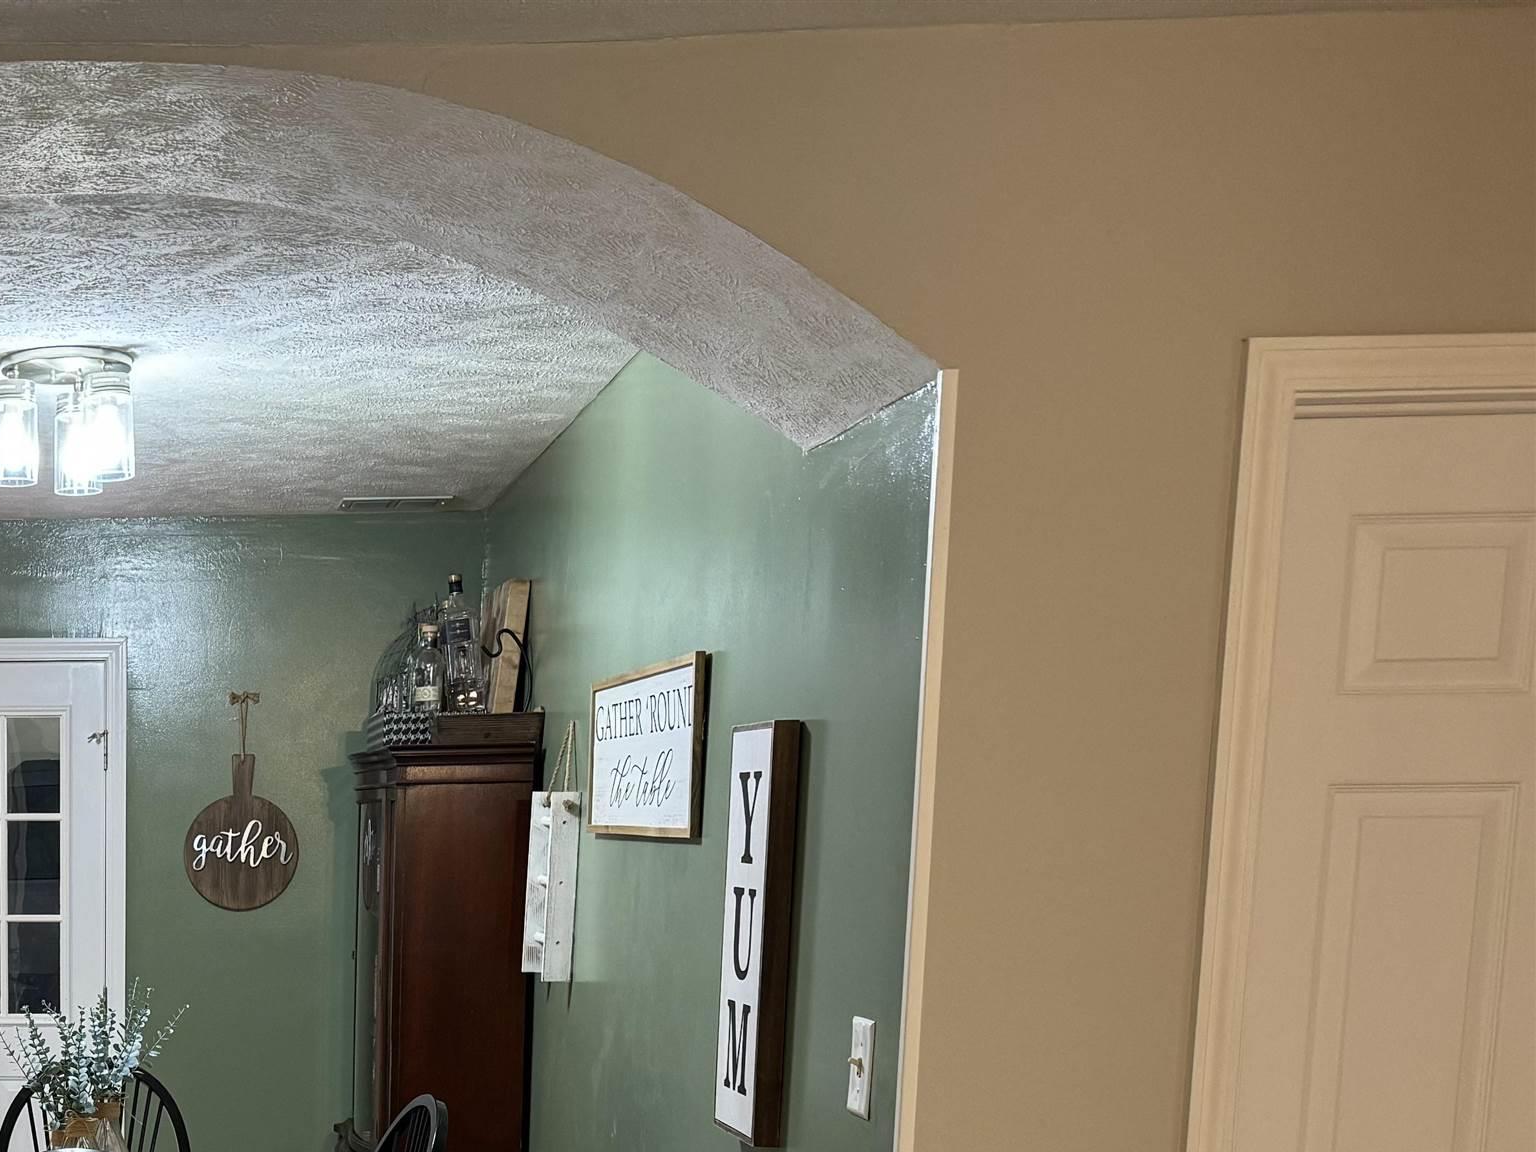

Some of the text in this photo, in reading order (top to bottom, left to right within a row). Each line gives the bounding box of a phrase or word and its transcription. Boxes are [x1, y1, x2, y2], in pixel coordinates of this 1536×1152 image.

[596, 698, 643, 742] GATHER
[609, 748, 677, 809] the table
[192, 819, 294, 871] gather
[724, 770, 763, 1097] YUM
